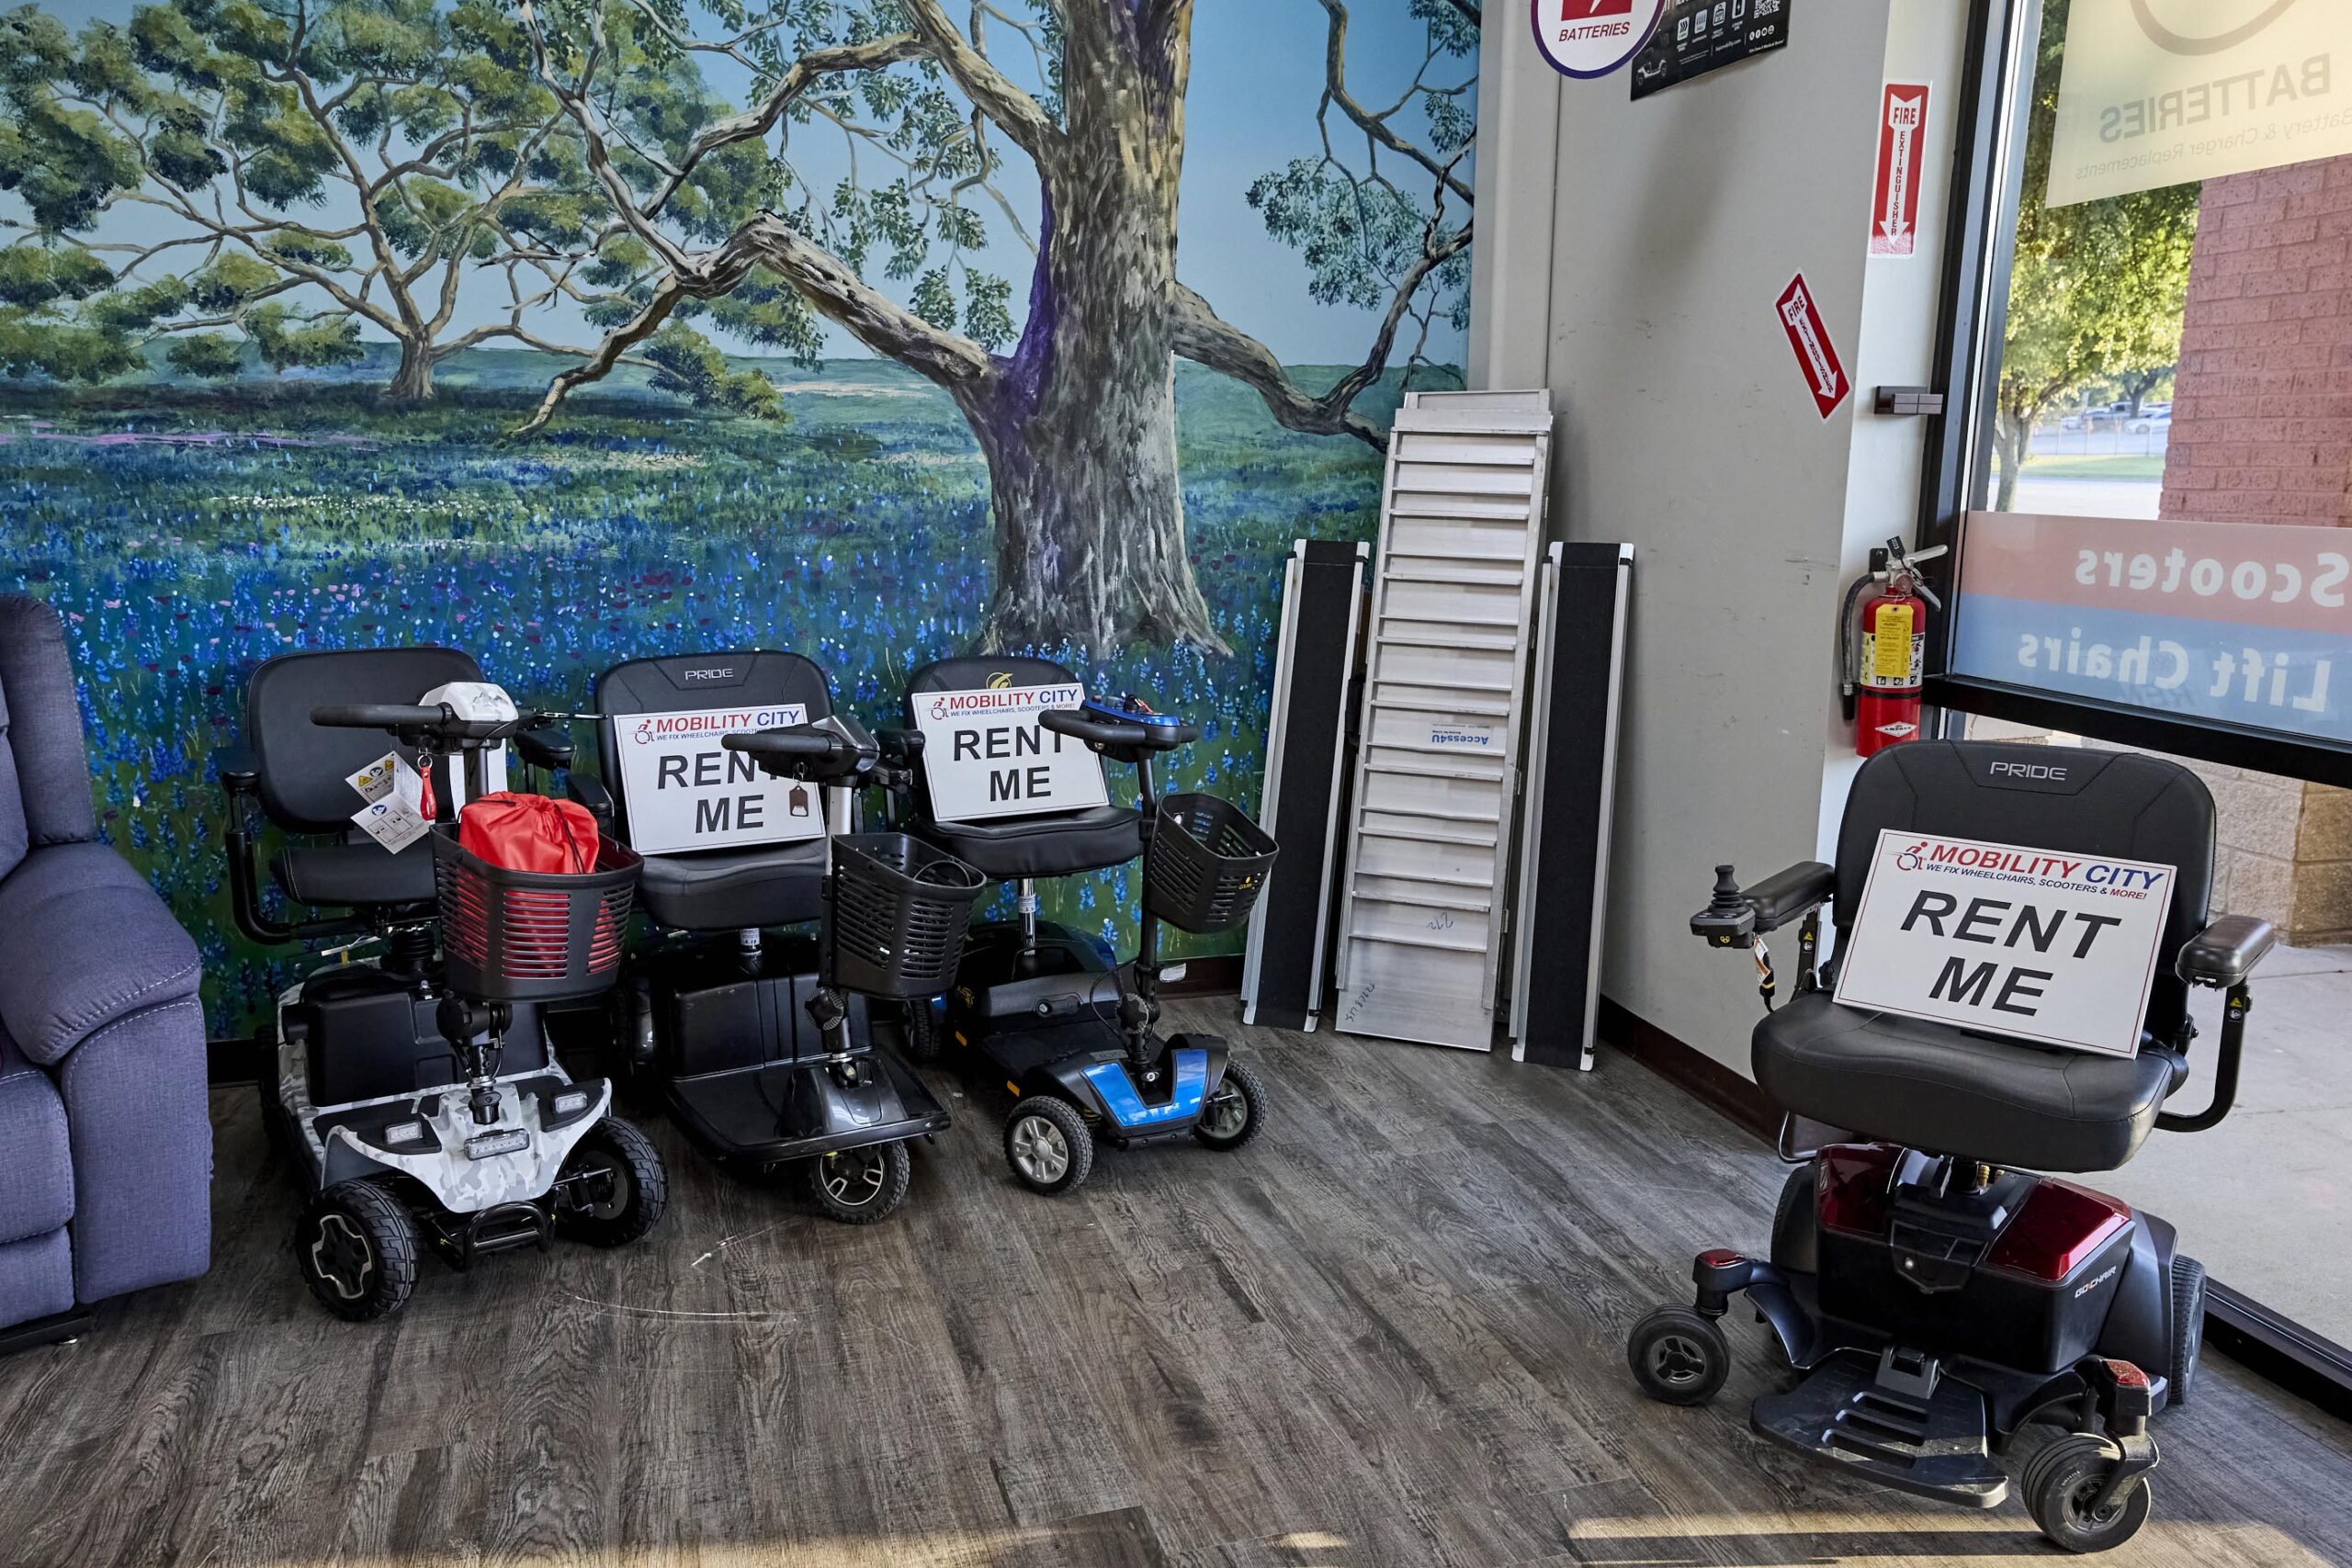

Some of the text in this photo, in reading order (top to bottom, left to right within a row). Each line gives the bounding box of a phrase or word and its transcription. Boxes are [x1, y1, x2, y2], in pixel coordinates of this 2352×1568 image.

[1558, 21, 1630, 42] BATTERIES
[1894, 107, 1917, 125] FIRE
[1891, 130, 1905, 236] EXTINGUISHER
[1787, 295, 1805, 321] FIRE
[1798, 317, 1834, 393] EXTINGUISHER
[684, 668, 735, 681] PRIDE
[950, 689, 1078, 710] MOBILITY CITY
[657, 710, 800, 733] MOBILITY CITY
[1431, 735, 1489, 745] Access4U
[658, 750, 777, 789] REN
[989, 766, 1052, 801] ME
[1989, 761, 2068, 781] PRIDE
[695, 794, 764, 833] ME
[1926, 863, 1943, 872] WE
[1943, 865, 1961, 874] FIX
[1961, 867, 2036, 886] WHEELCHAIRS,
[2039, 878, 2098, 894] SCOOTERS
[2109, 888, 2148, 900] MORE!
[1929, 844, 2165, 890] MOBILITY CITY
[1900, 889, 2122, 959] RENT
[1928, 955, 2054, 1017] ME
